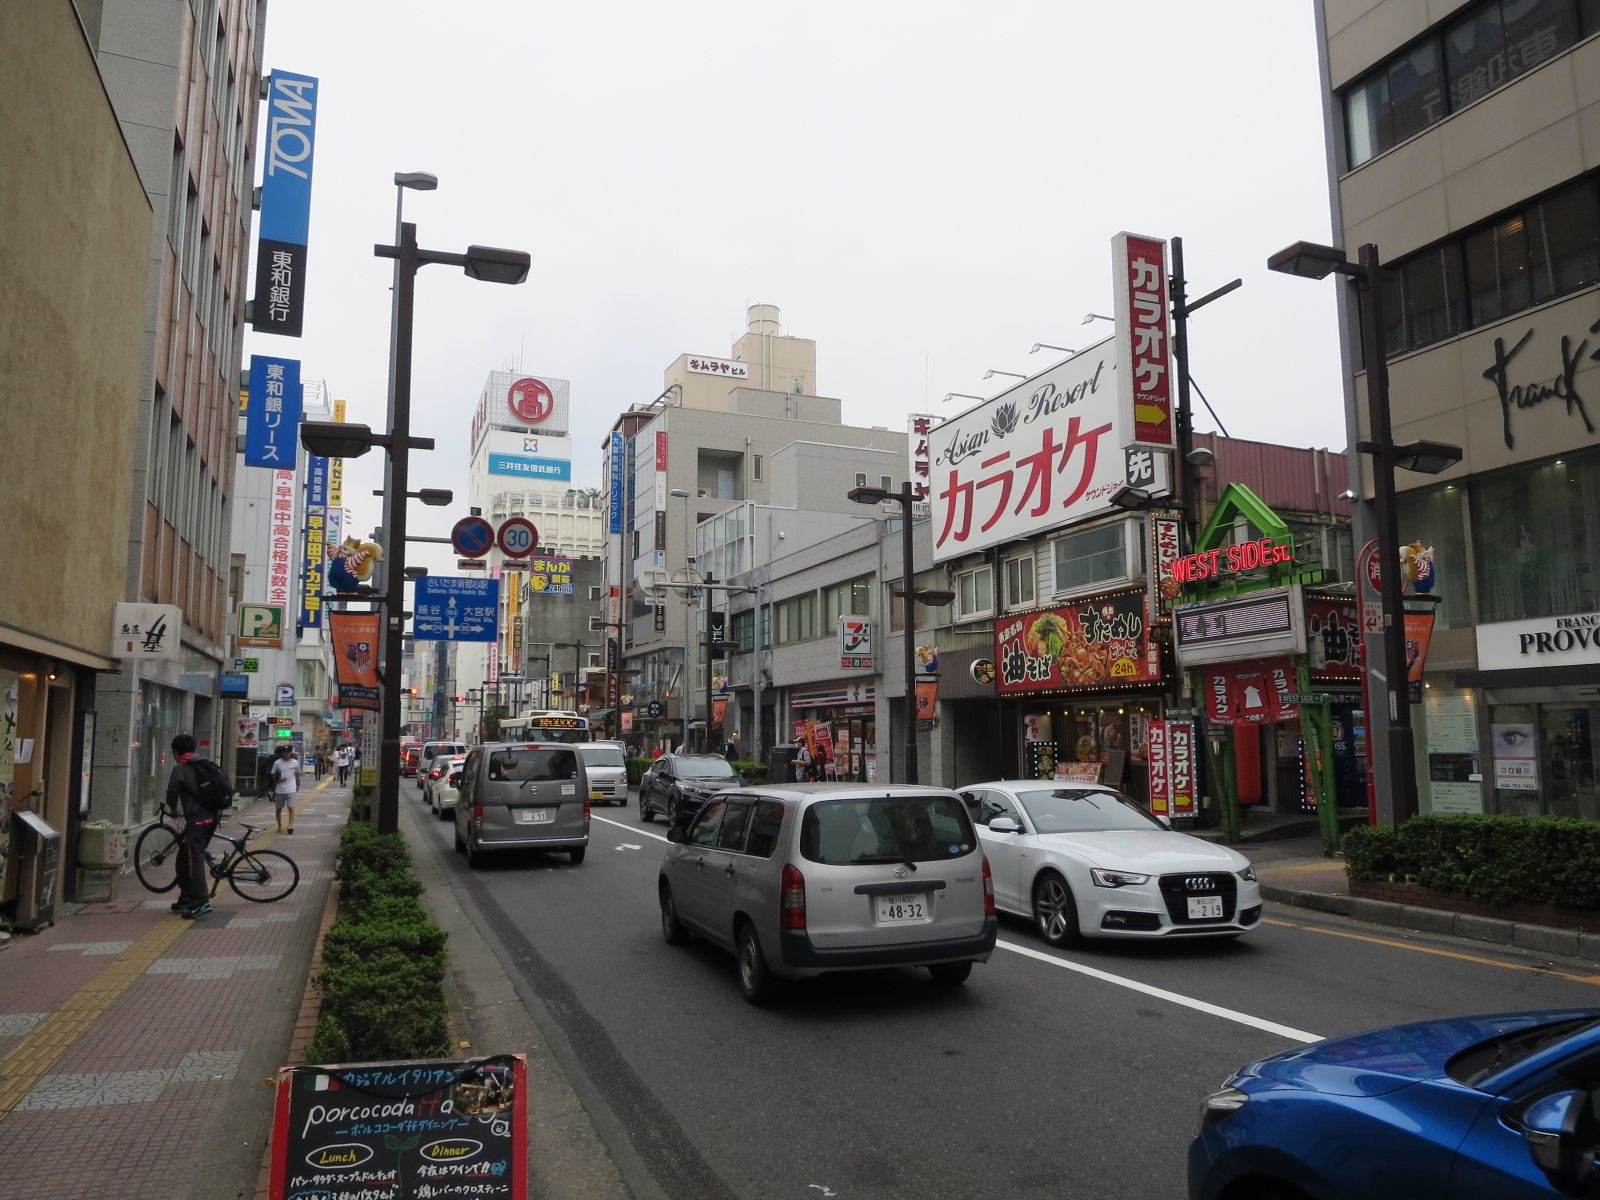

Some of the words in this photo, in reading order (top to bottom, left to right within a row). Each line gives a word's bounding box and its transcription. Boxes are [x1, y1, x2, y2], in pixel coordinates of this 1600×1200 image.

[268, 77, 314, 180] TOWA
[268, 249, 293, 323] 東和銀行
[1131, 256, 1165, 391] カラオケ
[261, 363, 285, 462] 東和銀リース
[936, 428, 991, 466] Asian
[1023, 360, 1105, 425] Resort
[498, 460, 561, 475] 三井住友信託銀行
[914, 417, 930, 502] キムラヤ
[936, 416, 1113, 550] カラオケ
[506, 529, 530, 548] 30
[1170, 549, 1221, 584] WEST
[1227, 537, 1273, 573] SIDE
[304, 515, 324, 623] 早稲田アカデミー
[427, 578, 489, 589] さいたま新都心駅
[533, 559, 571, 573] まんが
[243, 607, 274, 637] P
[463, 606, 495, 617] 大宮駅
[1078, 605, 1142, 646] すためし
[234, 658, 244, 670] P
[1002, 638, 1052, 686] 油そば
[1114, 662, 1134, 675] 24h
[1213, 675, 1229, 714] カラオケ
[1150, 726, 1166, 793] カラオケ
[1173, 730, 1190, 790] カラオケ
[319, 1151, 357, 1164] Lunch
[431, 1144, 470, 1157] Dinner
